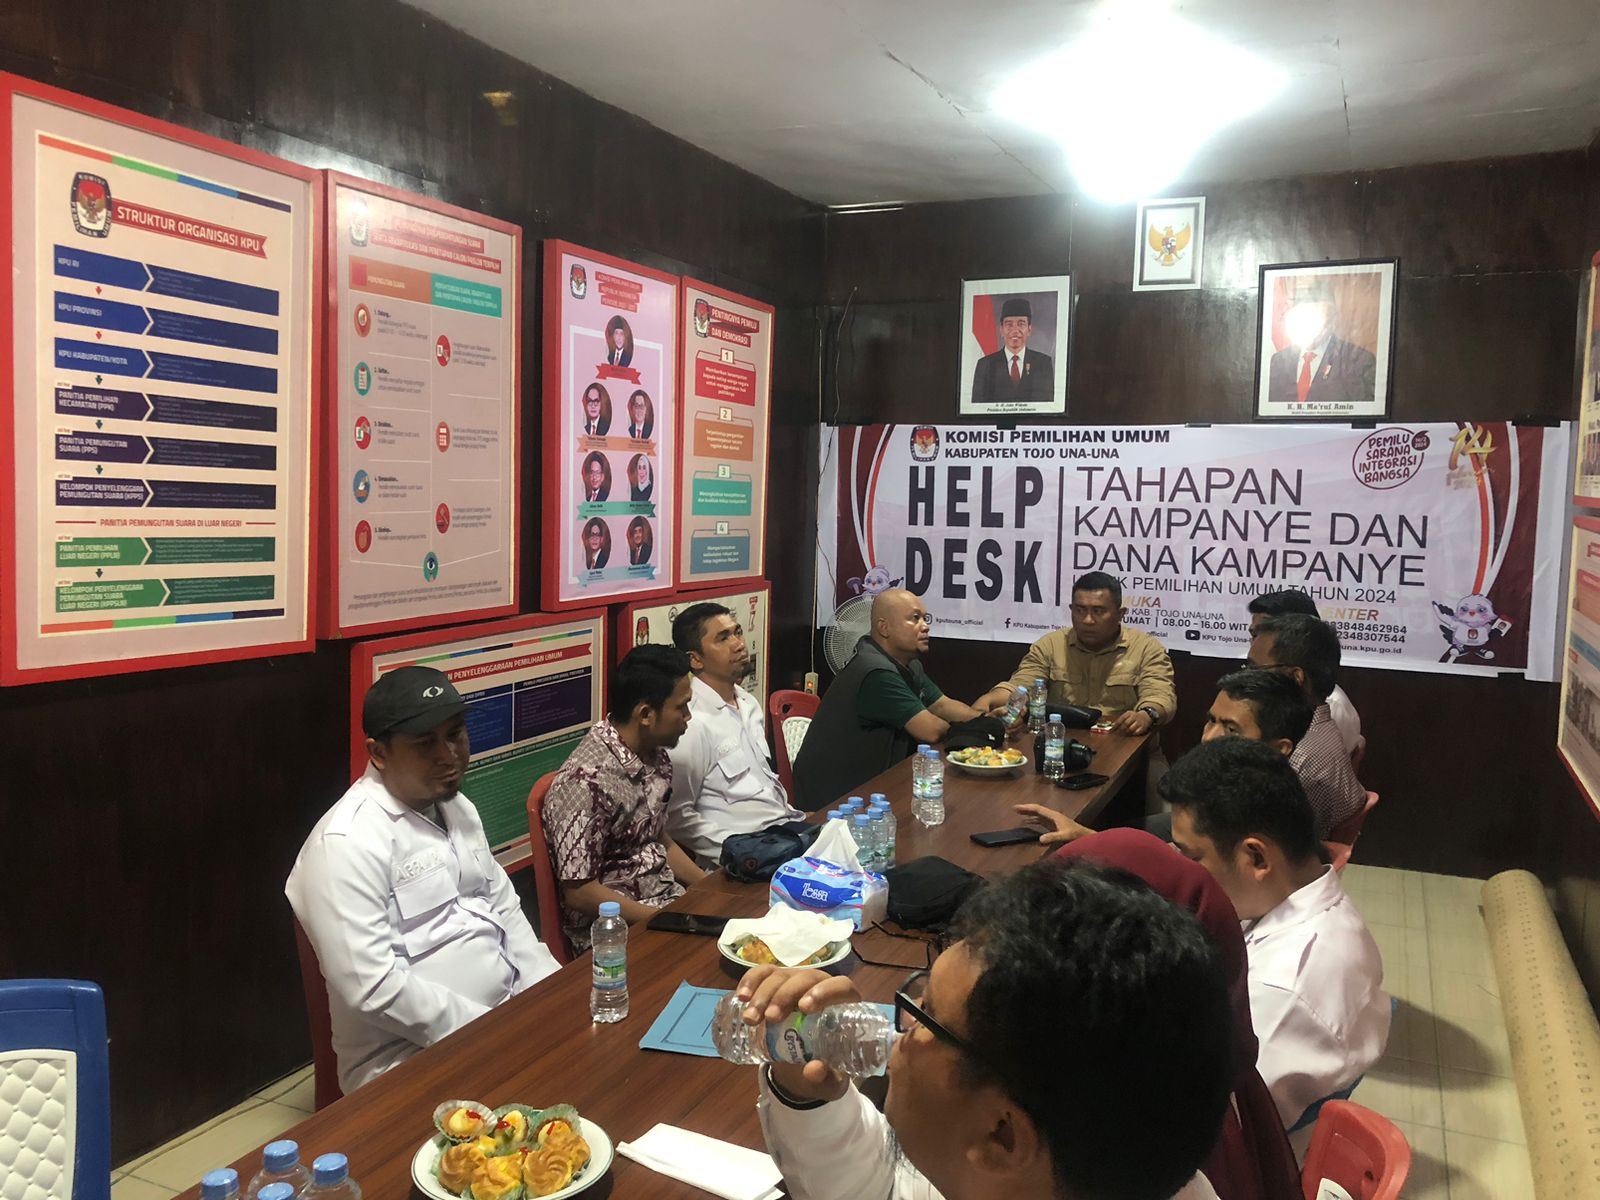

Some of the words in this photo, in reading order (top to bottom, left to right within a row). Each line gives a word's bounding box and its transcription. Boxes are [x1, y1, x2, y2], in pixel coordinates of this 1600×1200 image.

[117, 206, 176, 231] STRUKTUR
[178, 221, 238, 246] ORGANISASI
[240, 237, 259, 251] KPU
[711, 308, 740, 324] PENTINGNYA
[740, 318, 758, 330] PEMILU
[711, 327, 722, 338] DAN
[722, 331, 748, 345] DEMOKRASI
[725, 351, 729, 360] 1
[723, 409, 728, 419] 2
[945, 430, 1004, 443] KOMISI
[1009, 430, 1106, 444] PEMILIHAN
[1111, 429, 1170, 443] UMUM
[1368, 433, 1410, 449] PEMILU
[944, 447, 1019, 459] KABUPATEN
[1022, 448, 1055, 459] TOJO
[1059, 448, 1119, 460] UNA-UNA
[1366, 444, 1411, 461] SARANA
[722, 467, 726, 476] 3
[1358, 455, 1417, 473] INTEGRASI
[1364, 467, 1410, 483] BANGSA
[1076, 465, 1303, 506] TAHAPAN
[908, 465, 1044, 529] HELP
[100, 518, 127, 527] PANITIA
[128, 518, 175, 527] PEMUNGUTAN
[175, 519, 196, 527] SUARA
[197, 519, 203, 527] DI
[204, 519, 220, 527] LUAR
[220, 519, 242, 527] NEGERI
[1074, 505, 1312, 545] KAMPANYE
[1329, 512, 1429, 549] DAN
[905, 537, 1043, 604] DESK
[1073, 541, 1180, 575] DANA
[1190, 545, 1426, 587] KAMPANYE
[1132, 576, 1223, 594] PEMILIHAN
[1354, 588, 1397, 604] 2024
[1131, 608, 1153, 617] KAB.
[1154, 609, 1180, 618] TOJO
[1182, 610, 1225, 621] UNA-UNA
[1322, 607, 1379, 621] ENTER
[1122, 616, 1152, 625] UMAT
[1162, 617, 1191, 627] 08.00
[1200, 620, 1227, 630] 16.00
[1228, 622, 1250, 632] WIT
[1201, 634, 1217, 642] KPU
[1218, 635, 1233, 643] Tojo
[1341, 644, 1402, 654] una.kpu.go.id
[454, 658, 514, 680] PENYELENGGARAAN
[514, 654, 545, 668] PEMILIHAN
[545, 651, 563, 661] UMUM
